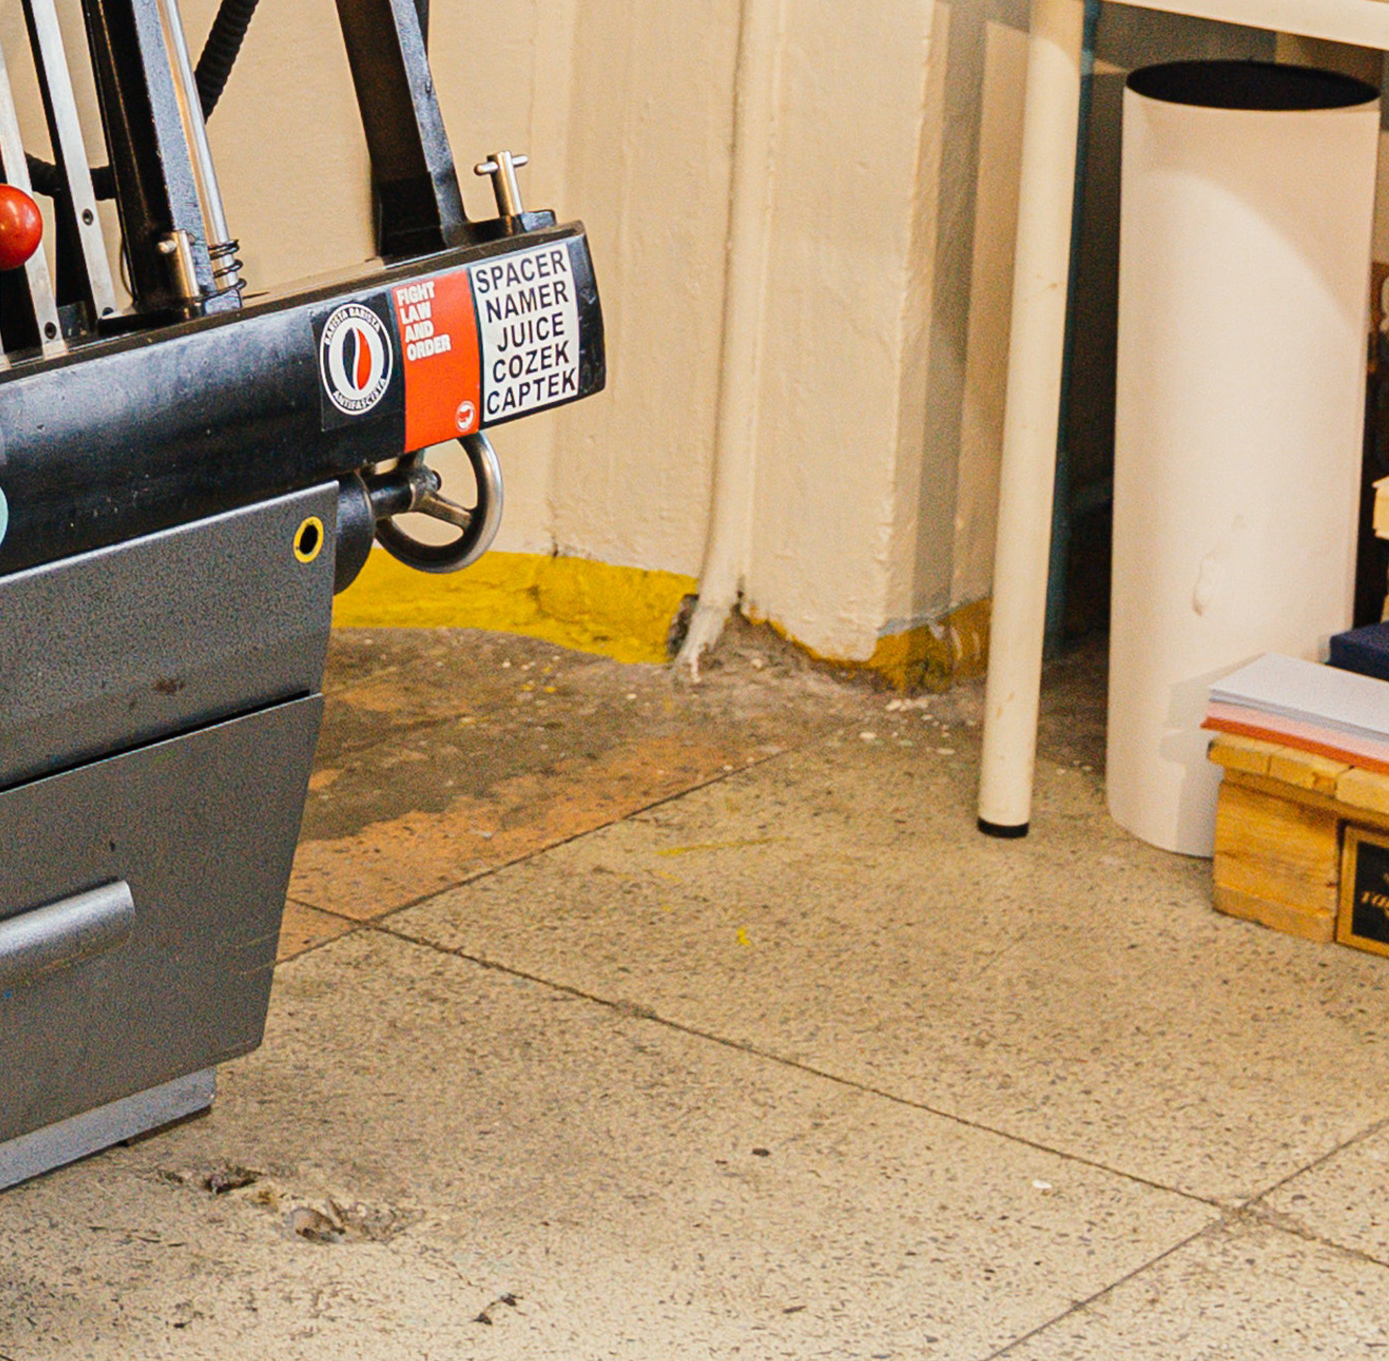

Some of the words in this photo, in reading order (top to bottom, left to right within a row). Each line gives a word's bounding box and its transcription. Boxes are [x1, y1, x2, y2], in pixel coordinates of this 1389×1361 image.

[475, 249, 567, 294] SPACER
[396, 281, 435, 307] FIGHT
[399, 301, 432, 325] LAW
[485, 280, 569, 324] NAMER
[405, 320, 435, 343] AND
[406, 334, 452, 362] ORDER
[497, 312, 565, 353] JUICE
[493, 340, 569, 383] COZEK
[486, 367, 576, 415] CAPTEK
